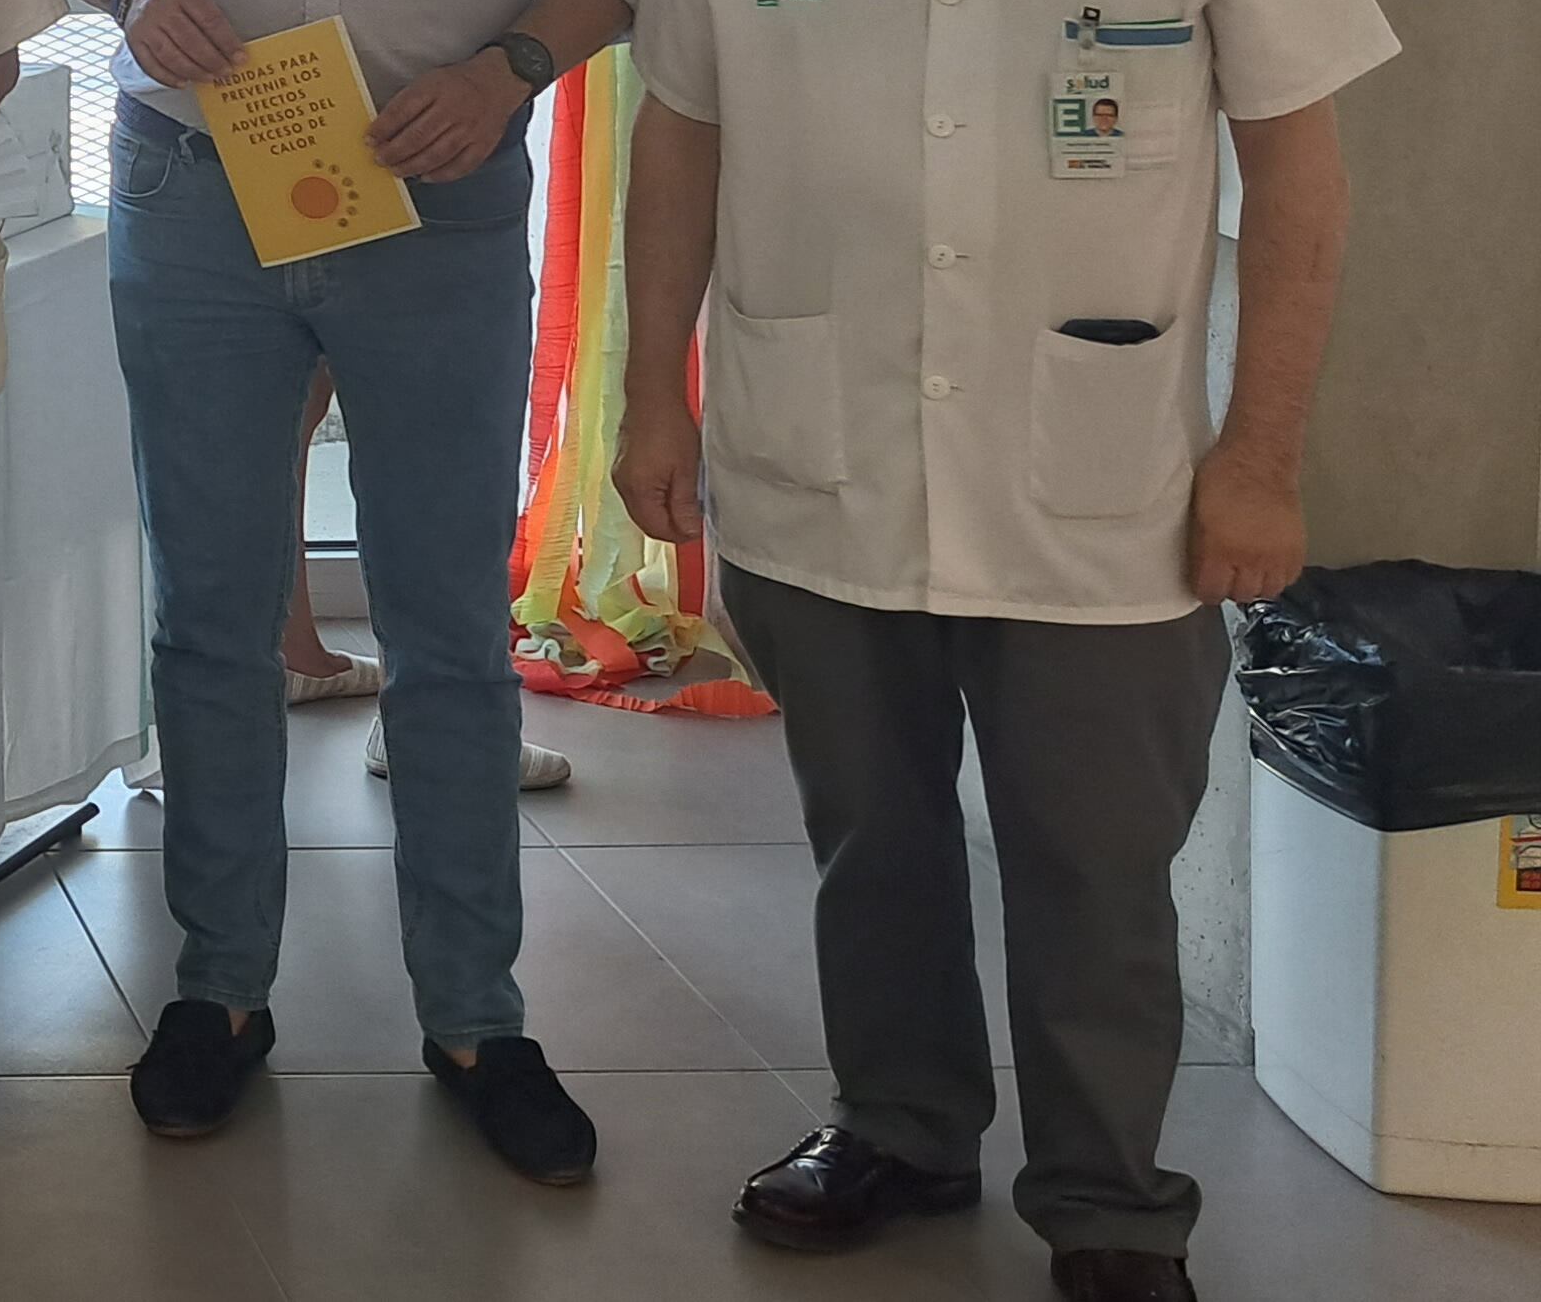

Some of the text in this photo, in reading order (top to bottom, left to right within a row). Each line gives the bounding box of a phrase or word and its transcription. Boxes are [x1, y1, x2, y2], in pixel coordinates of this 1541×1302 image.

[213, 51, 319, 89] MEDIDAS PARA
[221, 67, 321, 103] PREVENIR LOS
[232, 97, 336, 133] ADVERSOS DEL
[246, 88, 307, 114] EFECTOS
[249, 116, 327, 145] EXCESO DE
[1056, 102, 1082, 133] E
[270, 135, 317, 156] CALOR
